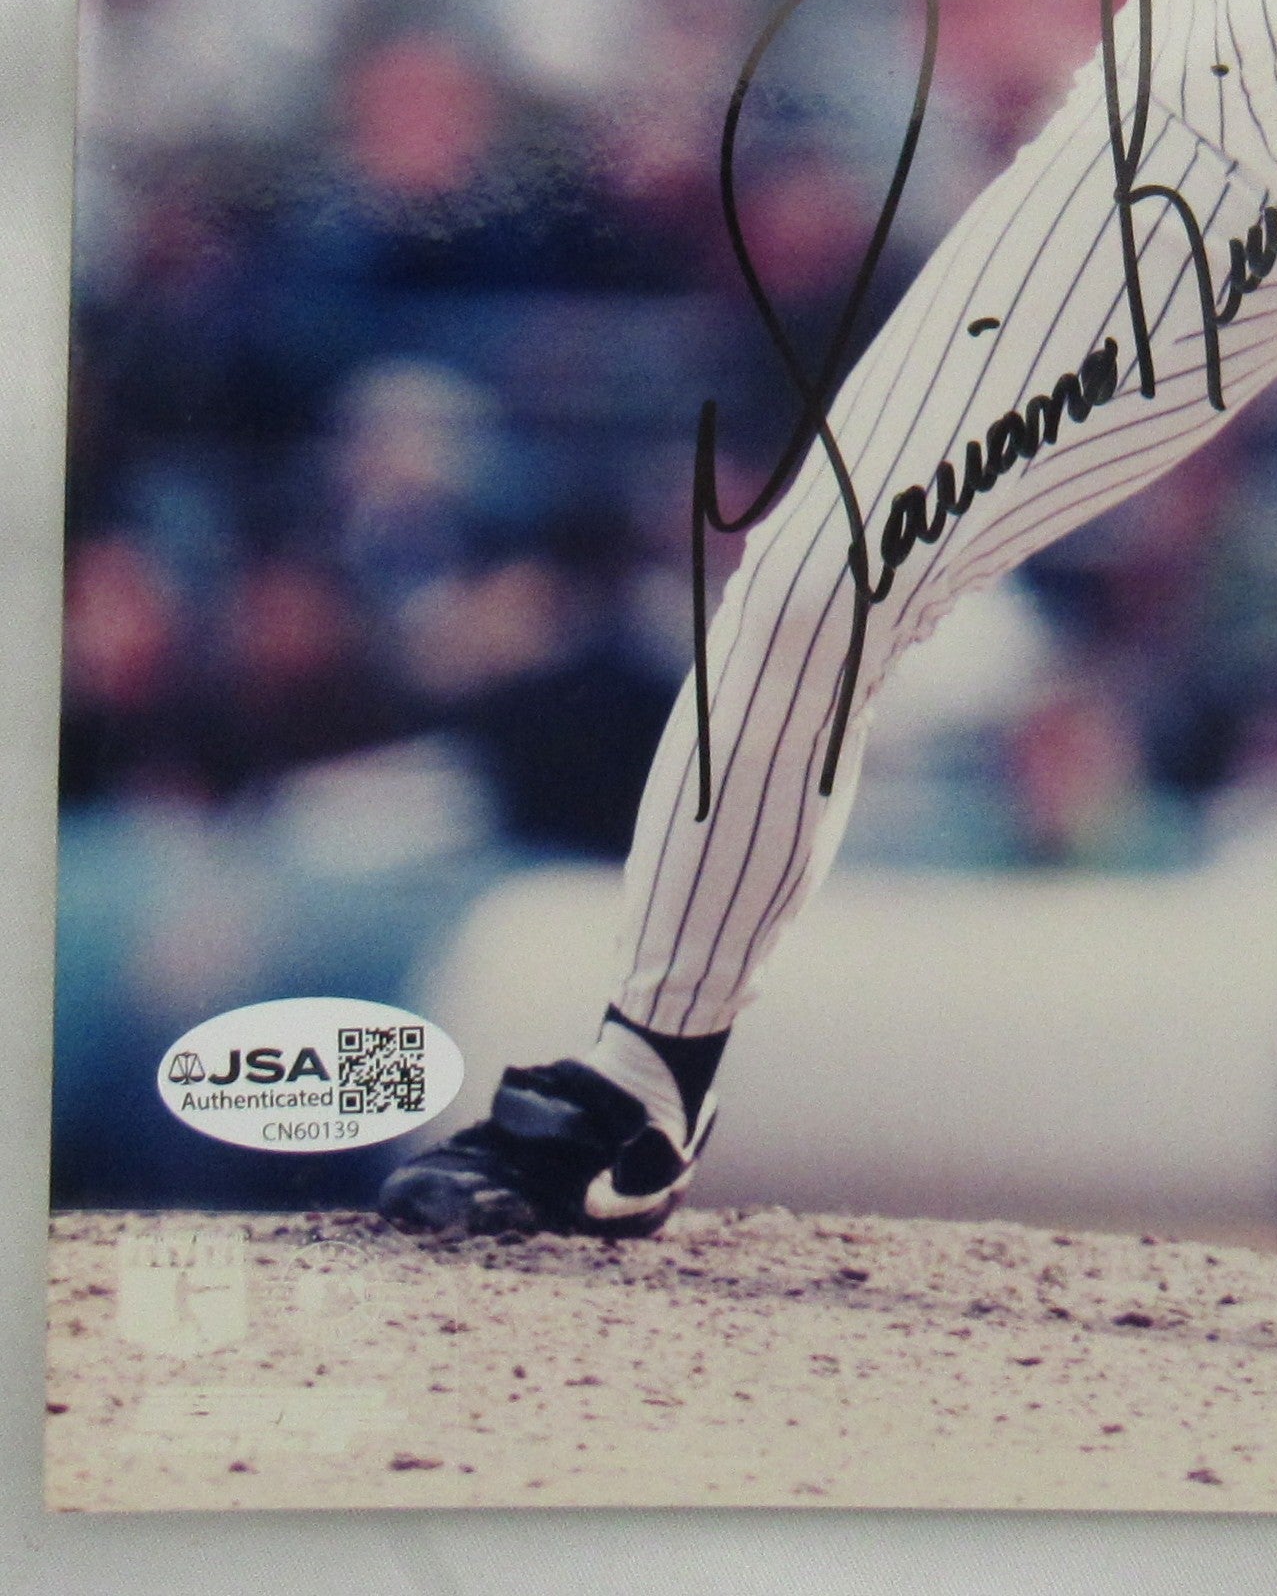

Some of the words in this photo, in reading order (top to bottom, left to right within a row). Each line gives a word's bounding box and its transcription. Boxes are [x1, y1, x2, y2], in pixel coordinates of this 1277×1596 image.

[208, 1047, 331, 1085] JSA
[181, 1087, 333, 1111] Authenticated
[262, 1120, 360, 1142] CN60139
